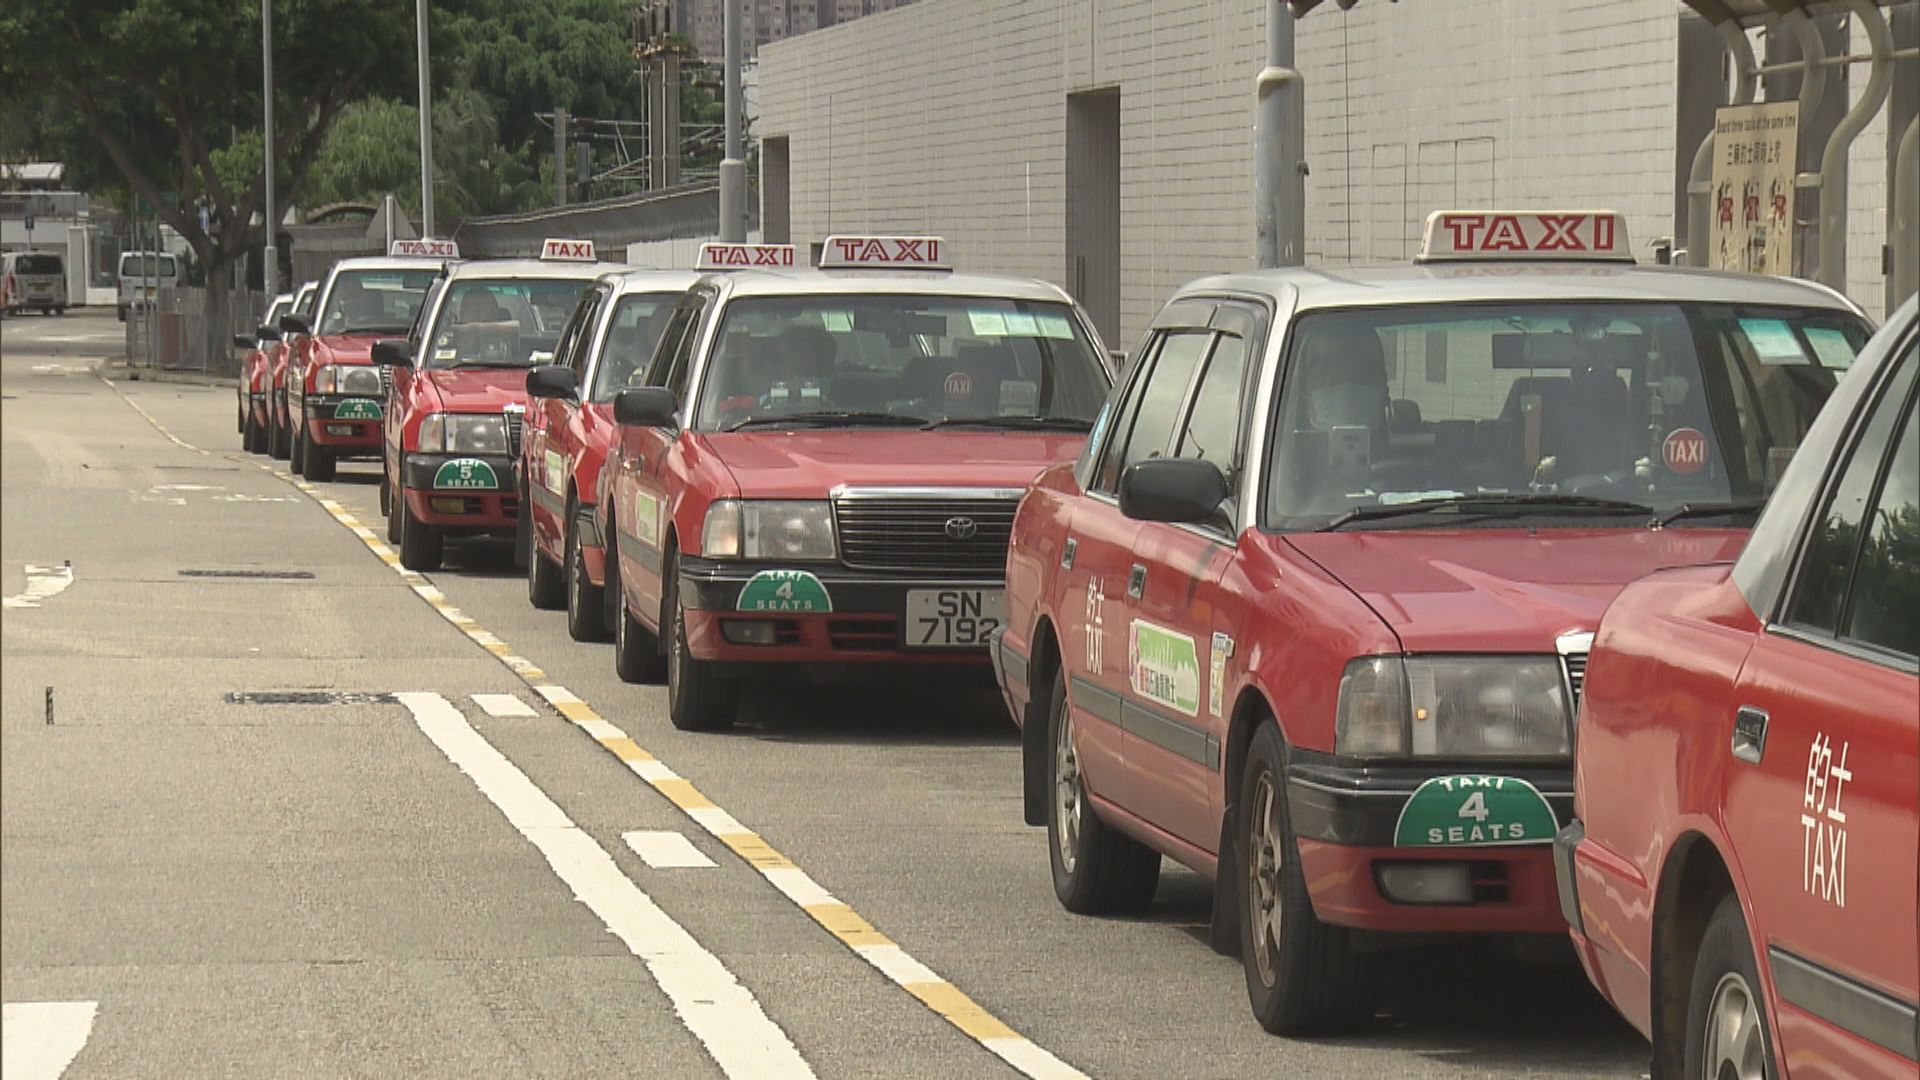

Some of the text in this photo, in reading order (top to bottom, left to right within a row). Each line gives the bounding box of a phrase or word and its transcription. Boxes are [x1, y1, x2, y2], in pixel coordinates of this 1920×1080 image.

[1771, 116, 1784, 129] same
[1784, 114, 1796, 128] time
[1444, 215, 1614, 250] TAXI
[399, 242, 453, 255] TAXI
[549, 242, 591, 257] TAXI
[707, 246, 794, 265] TAXI
[836, 239, 938, 262] TAXI
[948, 381, 969, 394] TAXI
[353, 403, 364, 411] 4
[1667, 440, 1704, 463] TAXI
[460, 466, 472, 479] 5
[766, 571, 803, 582] TAXI
[775, 581, 793, 600] 4
[1086, 576, 1105, 625] 的士
[756, 600, 813, 609] SEATS
[938, 592, 982, 617] SN
[918, 618, 999, 644] 7192
[1085, 623, 1104, 676] TAXI
[1438, 776, 1505, 792] TAXI
[1804, 731, 1852, 824] 的士
[1458, 791, 1489, 822] 4
[1428, 822, 1525, 844] SEATS
[1801, 813, 1848, 908] TAXI
